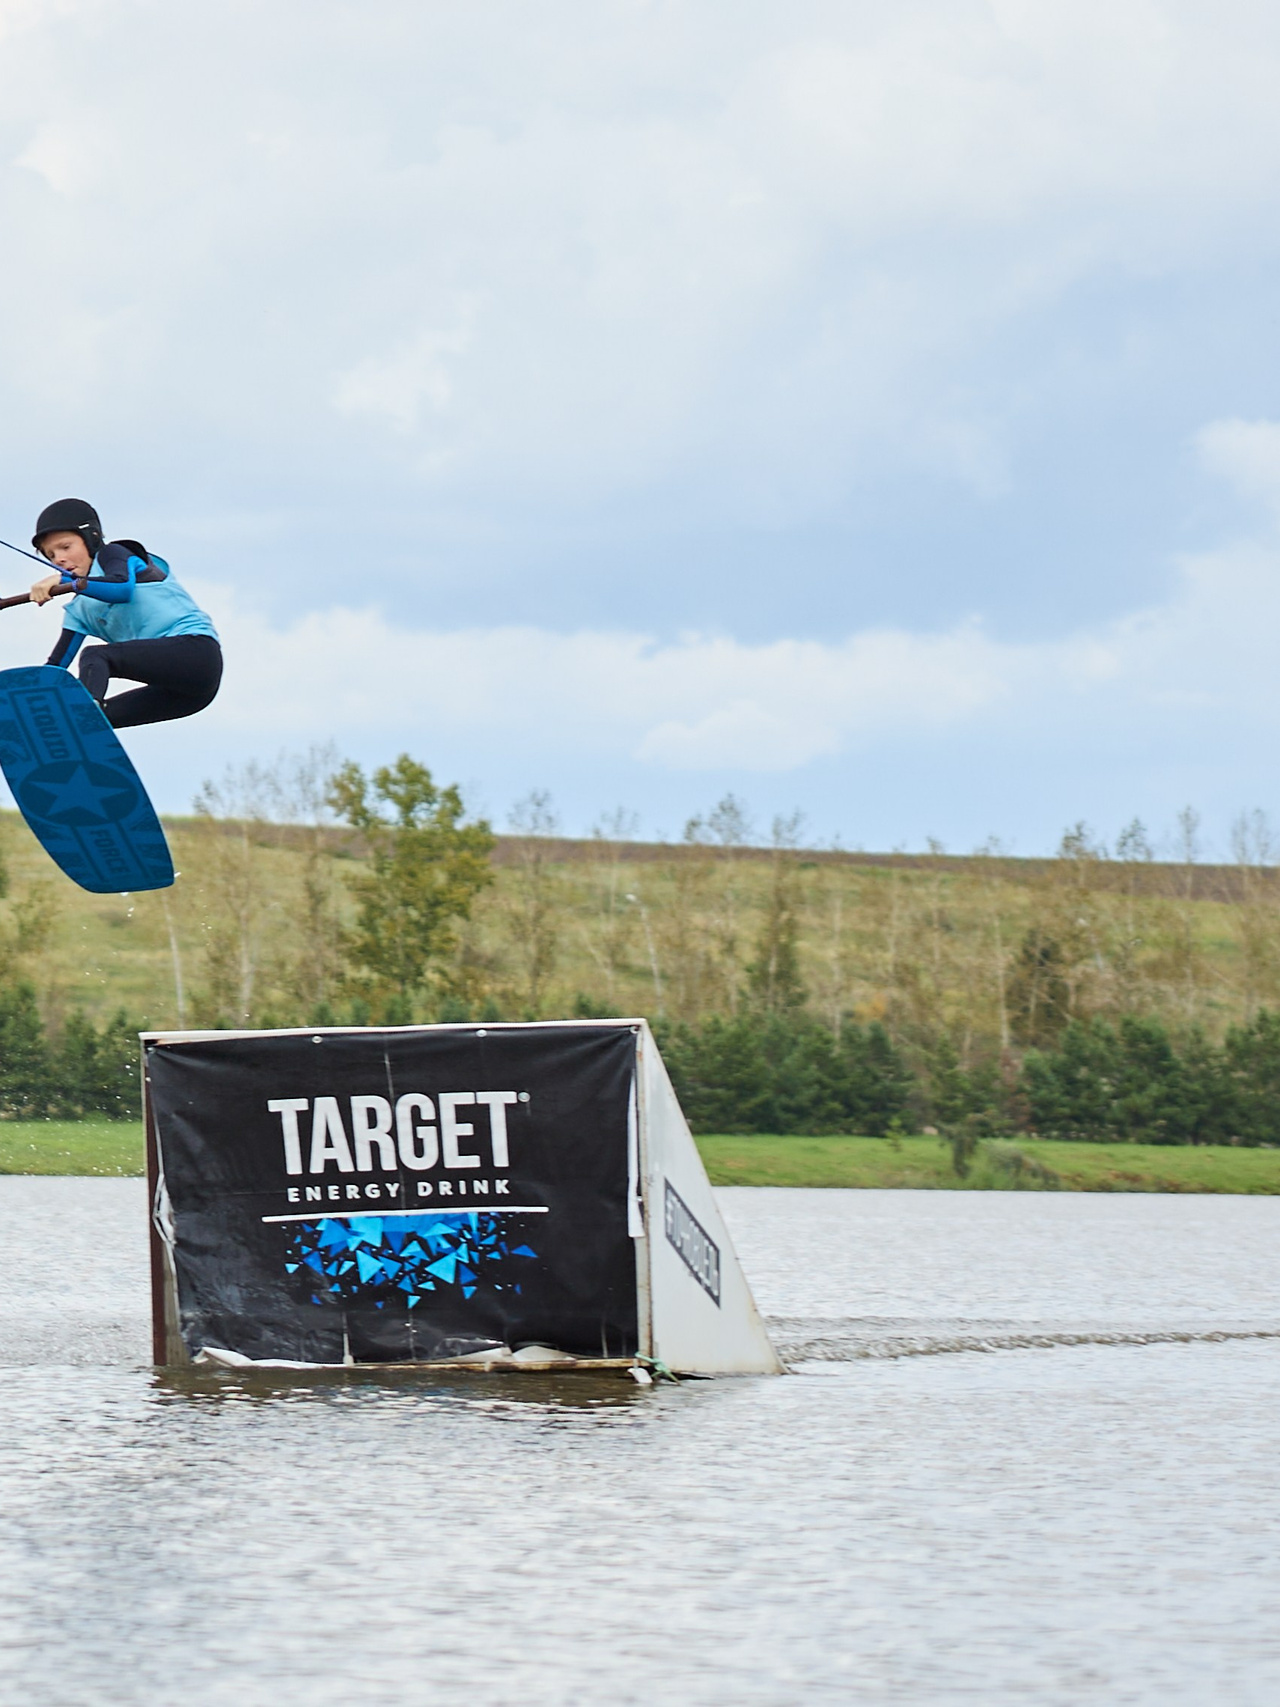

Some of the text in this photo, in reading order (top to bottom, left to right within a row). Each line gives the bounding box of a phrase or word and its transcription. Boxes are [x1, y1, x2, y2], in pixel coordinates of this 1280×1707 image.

[25, 695, 131, 873] LIQUID FORCE
[267, 1090, 518, 1175] TARGET
[286, 1179, 510, 1202] ENERGY DRINK
